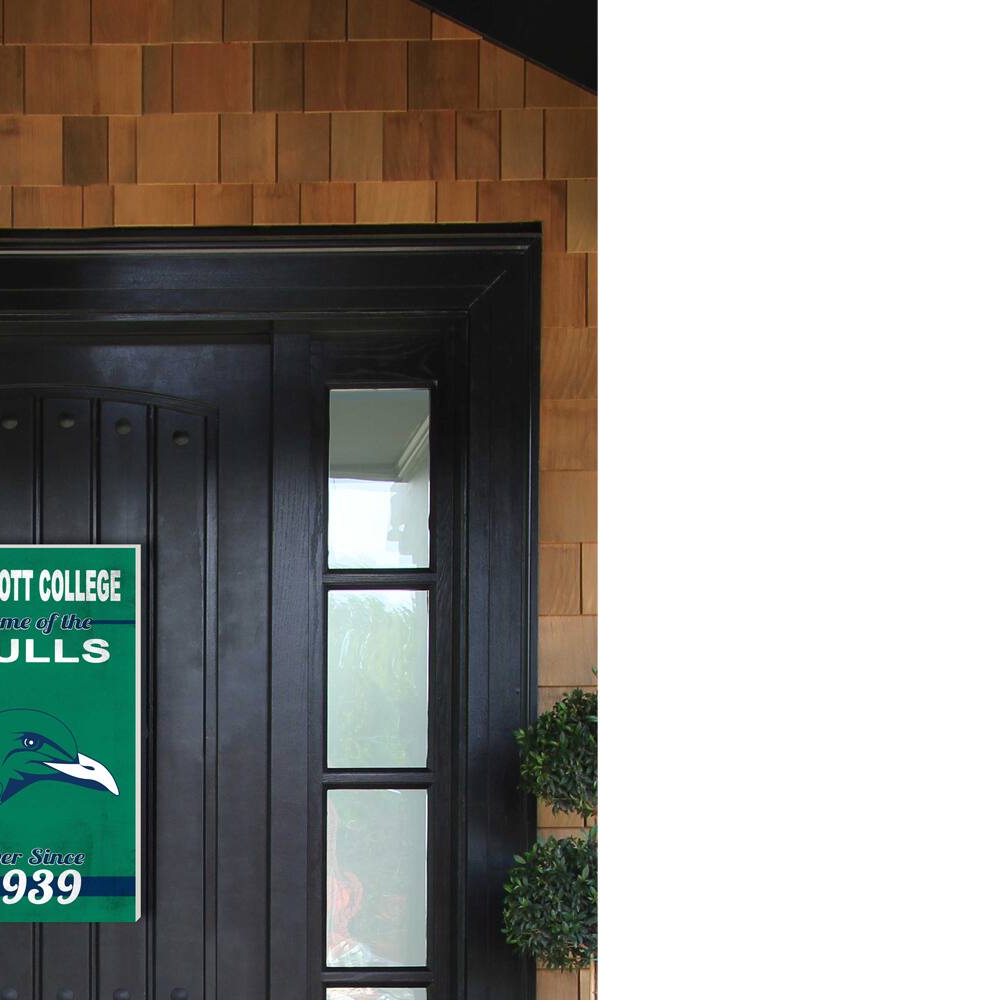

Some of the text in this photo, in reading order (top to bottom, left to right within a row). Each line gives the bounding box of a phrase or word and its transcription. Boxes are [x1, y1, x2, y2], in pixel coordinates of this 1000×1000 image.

[38, 569, 121, 602] COLLEGE
[35, 611, 60, 635] of
[60, 613, 93, 631] the
[27, 847, 86, 866] Since
